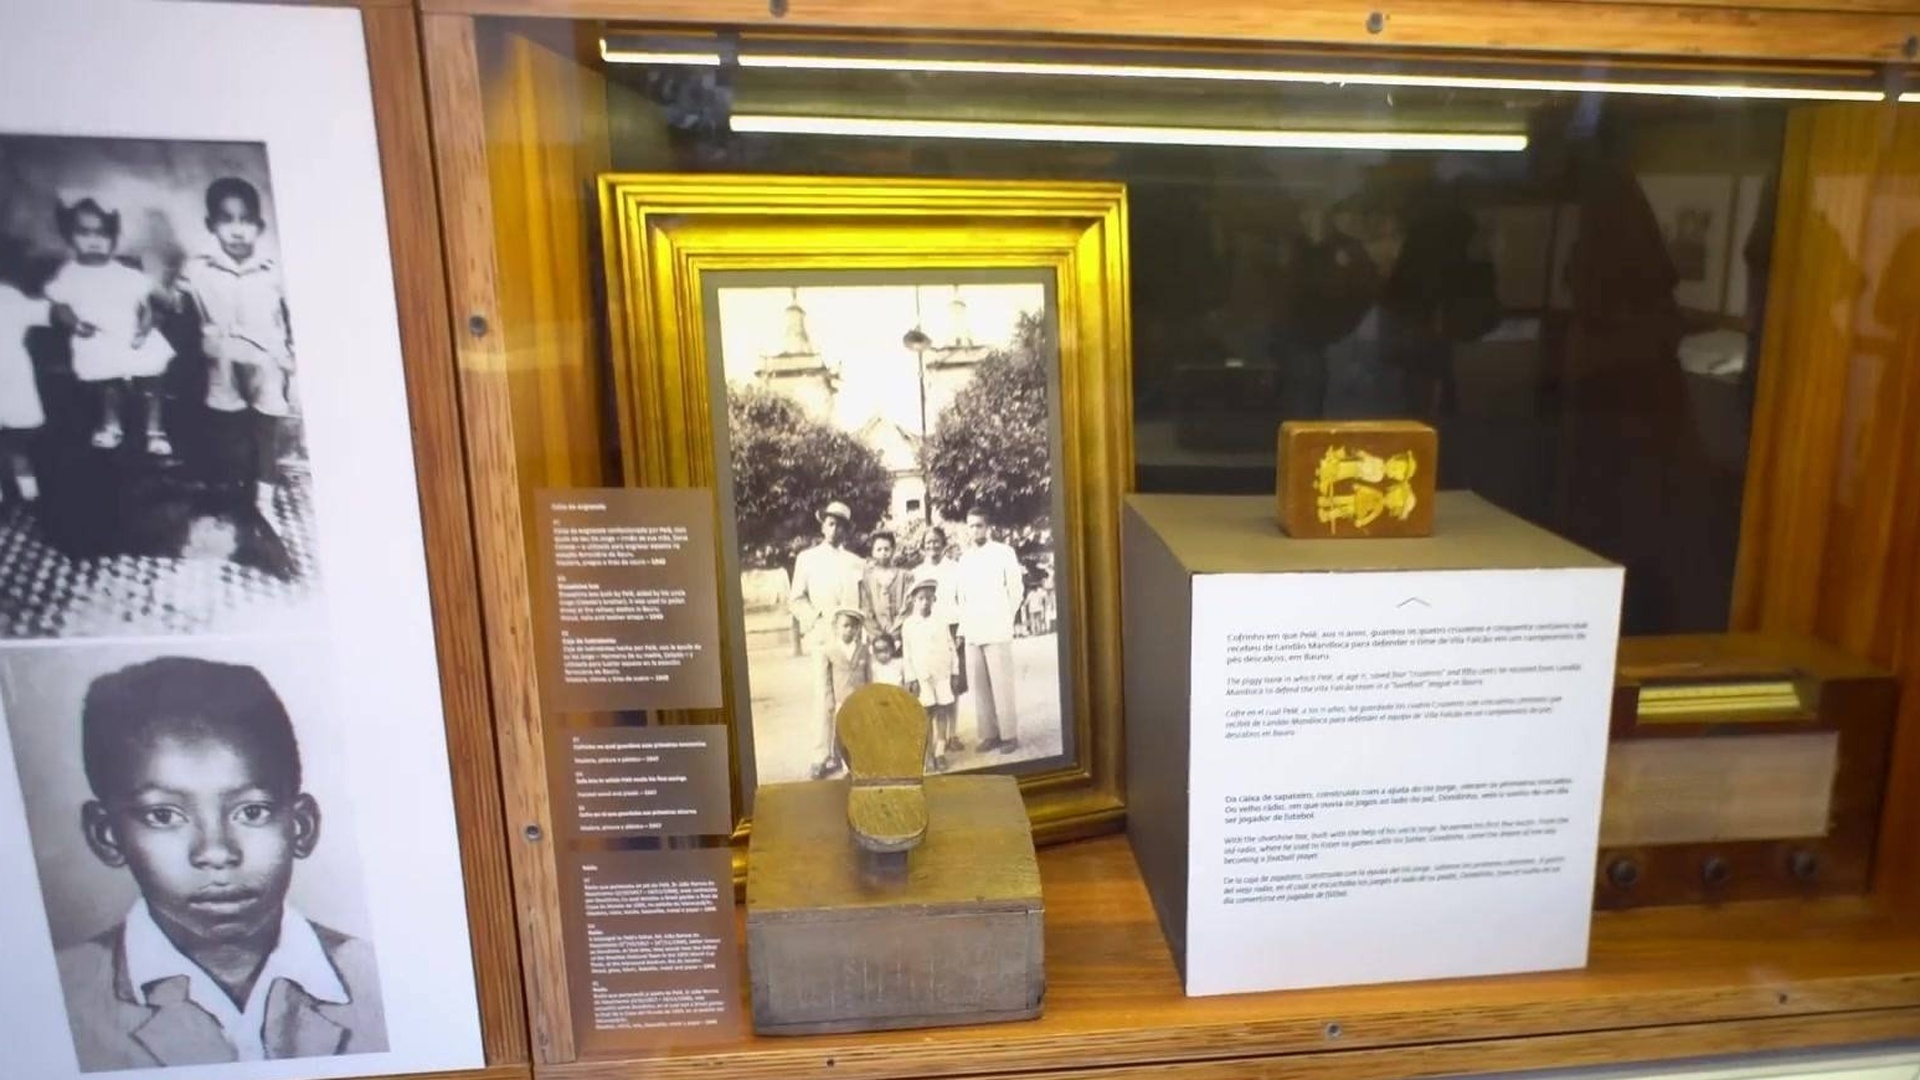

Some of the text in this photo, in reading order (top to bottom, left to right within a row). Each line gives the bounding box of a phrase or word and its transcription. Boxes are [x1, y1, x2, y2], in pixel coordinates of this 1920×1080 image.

[1227, 632, 1264, 641] Cofrinho
[1282, 632, 1297, 641] que
[1419, 626, 1445, 636] quatro
[1227, 643, 1260, 652] recebeu
[1263, 643, 1273, 651] de
[1275, 641, 1306, 650] Landão
[1308, 640, 1349, 649] Mandioca
[1351, 641, 1369, 649] para
[1371, 638, 1408, 647] defender
[1417, 637, 1436, 645] time
[1438, 636, 1449, 644] de
[1450, 636, 1465, 644] Vila
[1466, 635, 1492, 643] Falcão
[1576, 631, 1587, 639] de
[1227, 654, 1242, 664] pés
[1227, 676, 1240, 684] The
[1241, 675, 1262, 685] piggy
[1264, 675, 1282, 683] bank
[1284, 674, 1291, 682] in
[1275, 685, 1299, 694] defend
[1300, 684, 1313, 692] the
[1225, 794, 1237, 803] Da
[1239, 793, 1260, 802] caixa
[1262, 792, 1272, 801] de
[1361, 788, 1379, 796] com
[1388, 785, 1410, 795] ajuda
[1411, 784, 1422, 793] do
[1239, 803, 1261, 812] velho
[1302, 801, 1319, 810] que
[1238, 813, 1271, 824] jogador
[1272, 813, 1283, 821] de
[1223, 835, 1241, 844] With
[1242, 834, 1256, 842] the
[1260, 843, 1281, 852] where
[1223, 854, 1259, 865] becoming
[1267, 853, 1295, 863] football
